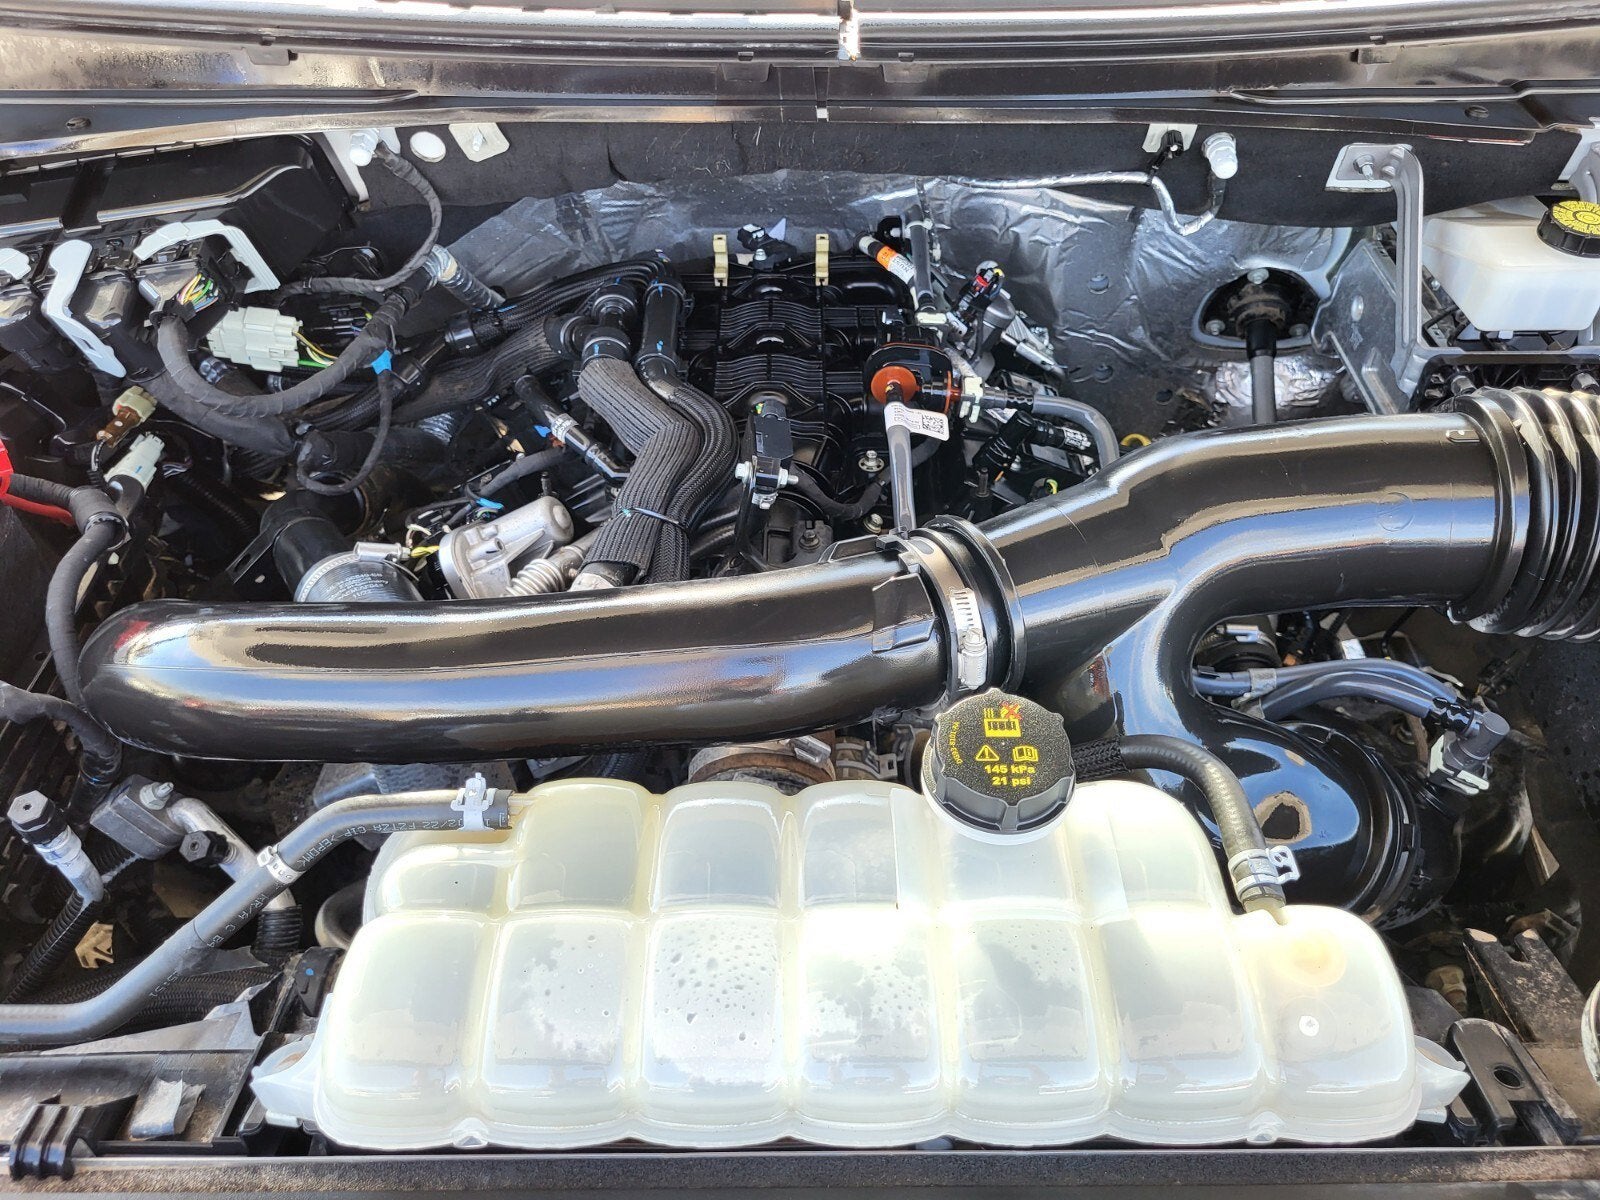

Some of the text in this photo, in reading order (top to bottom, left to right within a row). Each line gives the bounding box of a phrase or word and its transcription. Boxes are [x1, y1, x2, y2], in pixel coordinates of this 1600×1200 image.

[984, 764, 1036, 774] 145 kPa
[992, 776, 1031, 787] 21 psi
